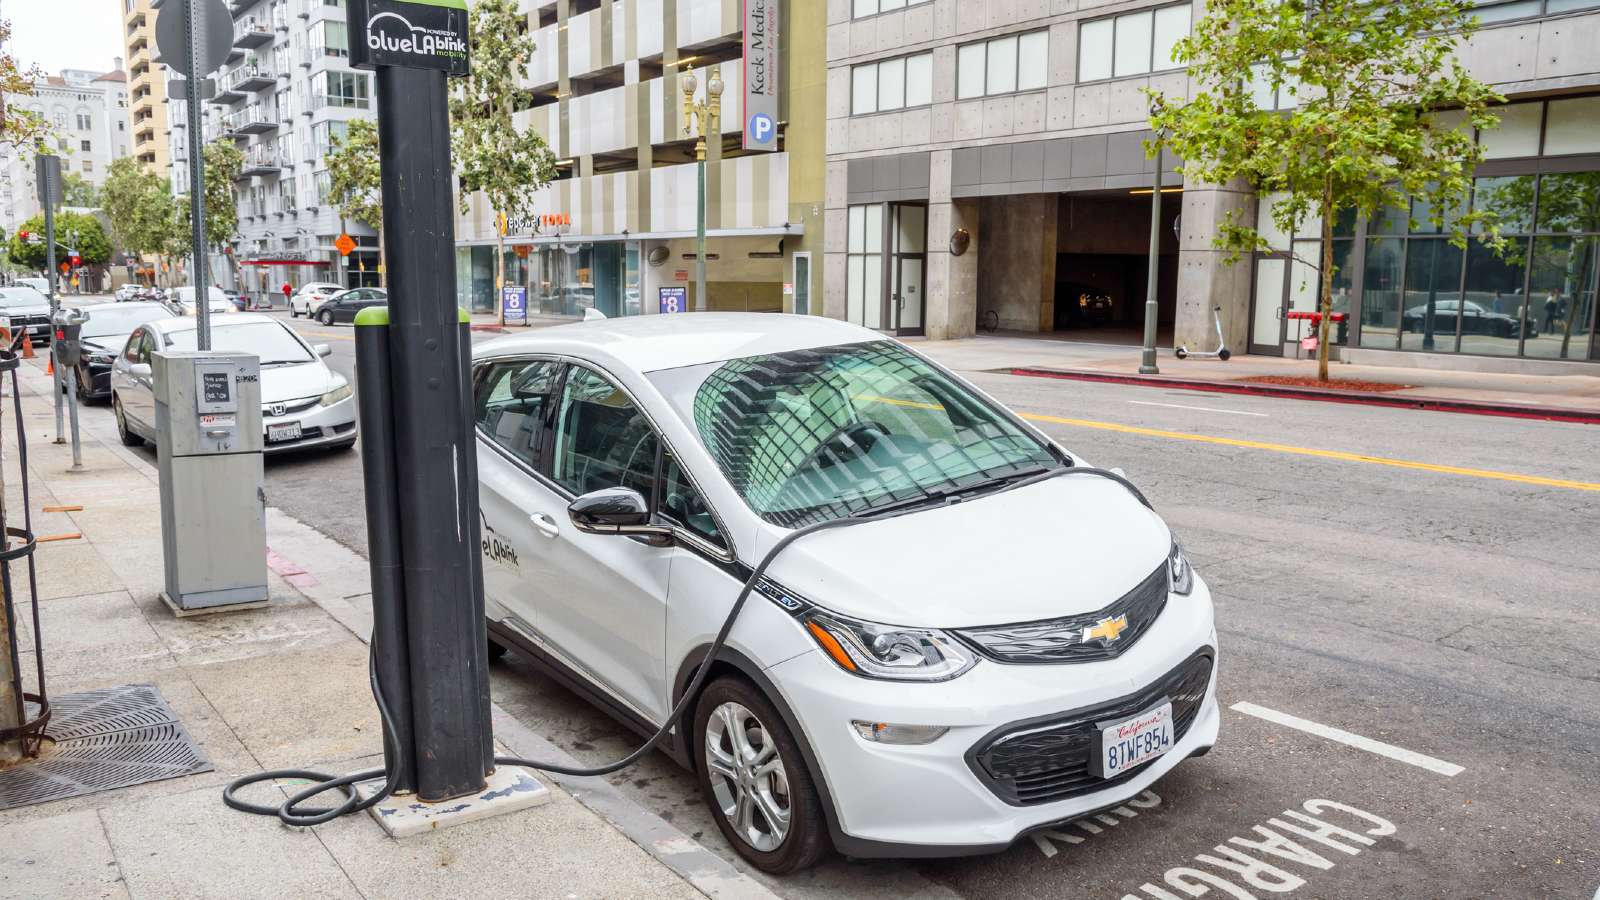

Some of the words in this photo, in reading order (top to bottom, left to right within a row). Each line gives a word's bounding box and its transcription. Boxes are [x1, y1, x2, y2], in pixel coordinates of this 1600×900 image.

[751, 0, 764, 51] Medic
[436, 50, 466, 60] mobility
[751, 57, 764, 96] Keck
[756, 117, 771, 139] P
[780, 596, 797, 607] EV
[1117, 715, 1161, 739] California
[1108, 724, 1169, 769] 8TWF854
